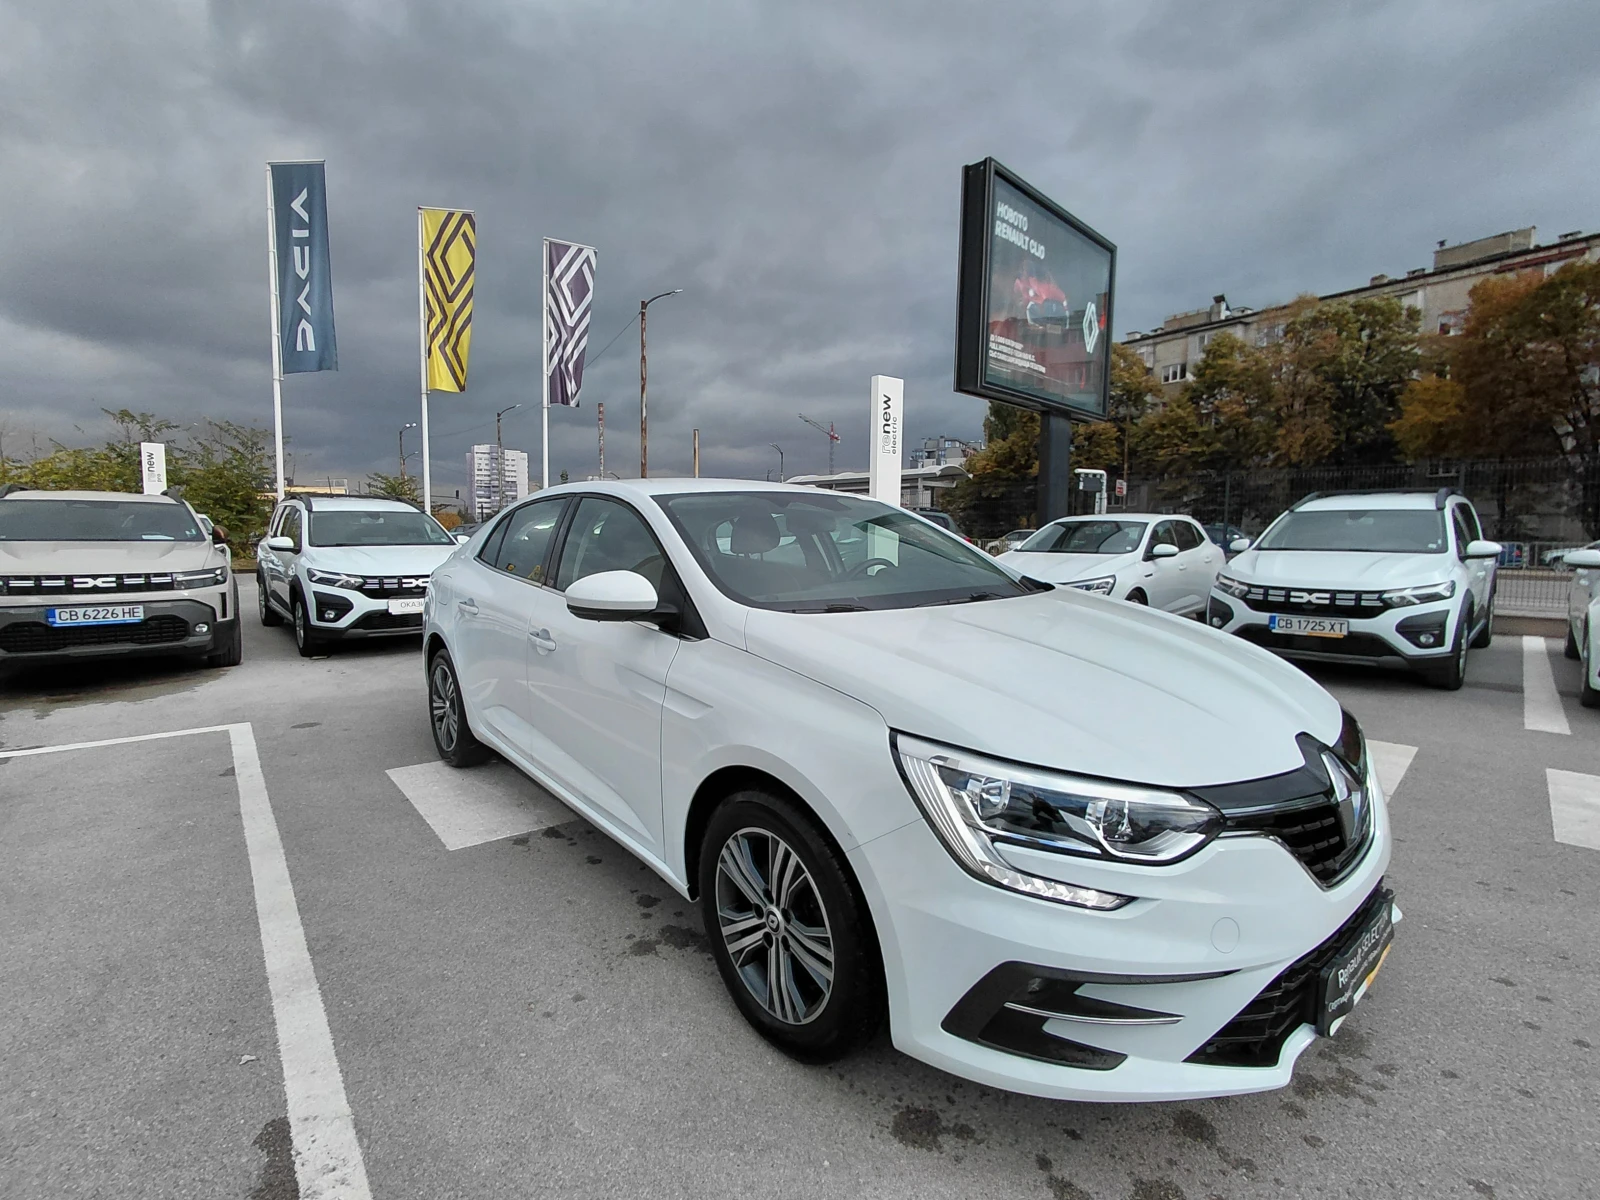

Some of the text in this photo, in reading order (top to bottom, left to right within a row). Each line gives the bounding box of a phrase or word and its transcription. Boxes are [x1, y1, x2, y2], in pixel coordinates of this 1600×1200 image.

[997, 201, 1028, 232] НОВОТО
[995, 220, 1045, 260] RENAULT CLIO
[290, 187, 316, 351] DACIA
[882, 394, 891, 454] renew
[83, 608, 119, 620] 6226
[1297, 619, 1326, 632] 1725
[1338, 947, 1362, 989] Renault
